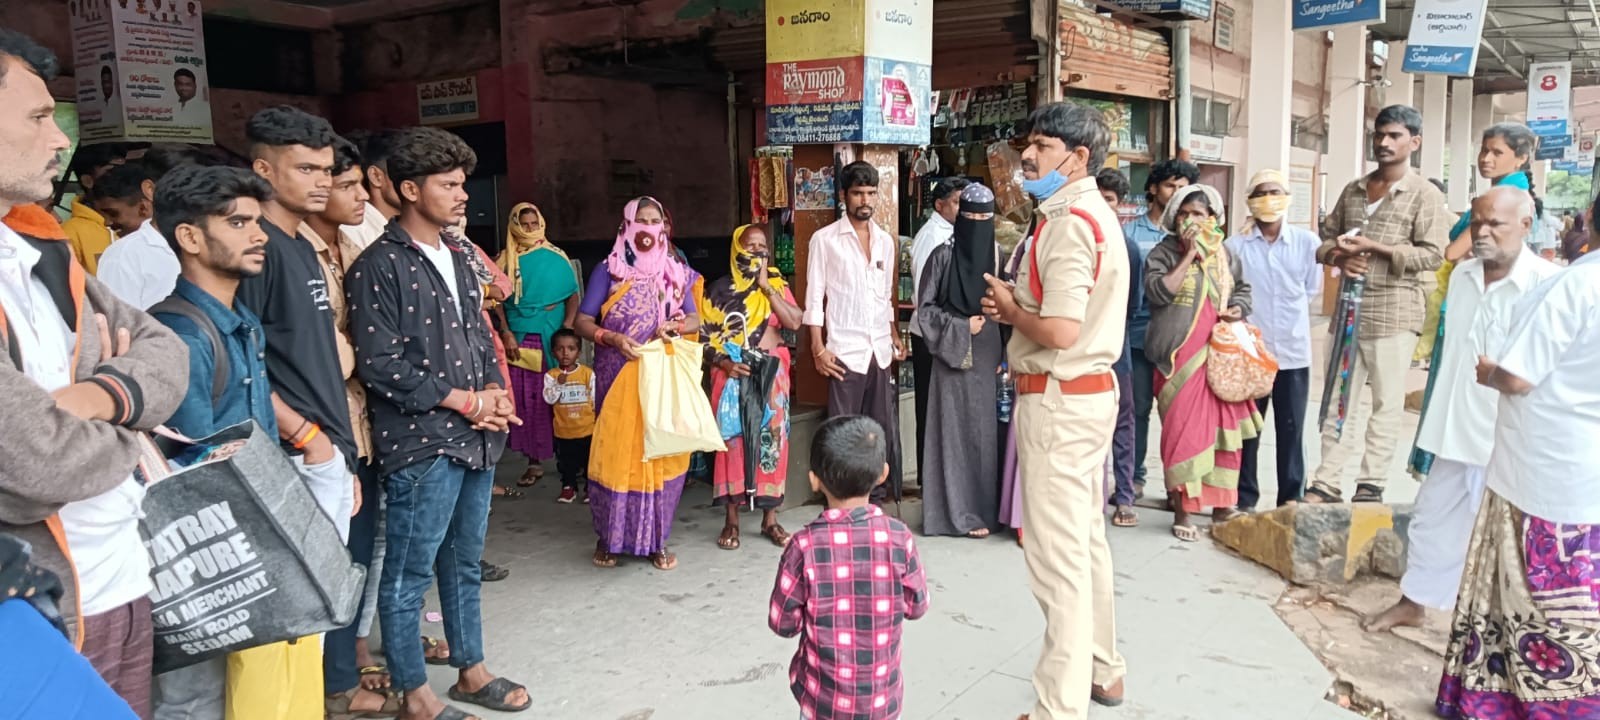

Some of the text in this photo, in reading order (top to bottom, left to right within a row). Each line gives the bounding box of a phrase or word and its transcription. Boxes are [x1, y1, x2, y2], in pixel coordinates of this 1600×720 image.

[1299, 0, 1355, 20] Sangeetha
[783, 63, 797, 72] THE
[818, 87, 845, 99] SHOP
[1540, 75, 1557, 91] 8
[179, 570, 269, 621] MERCHANT
[164, 609, 250, 645] MAIN ROAD
[180, 624, 254, 655] SEDAM
